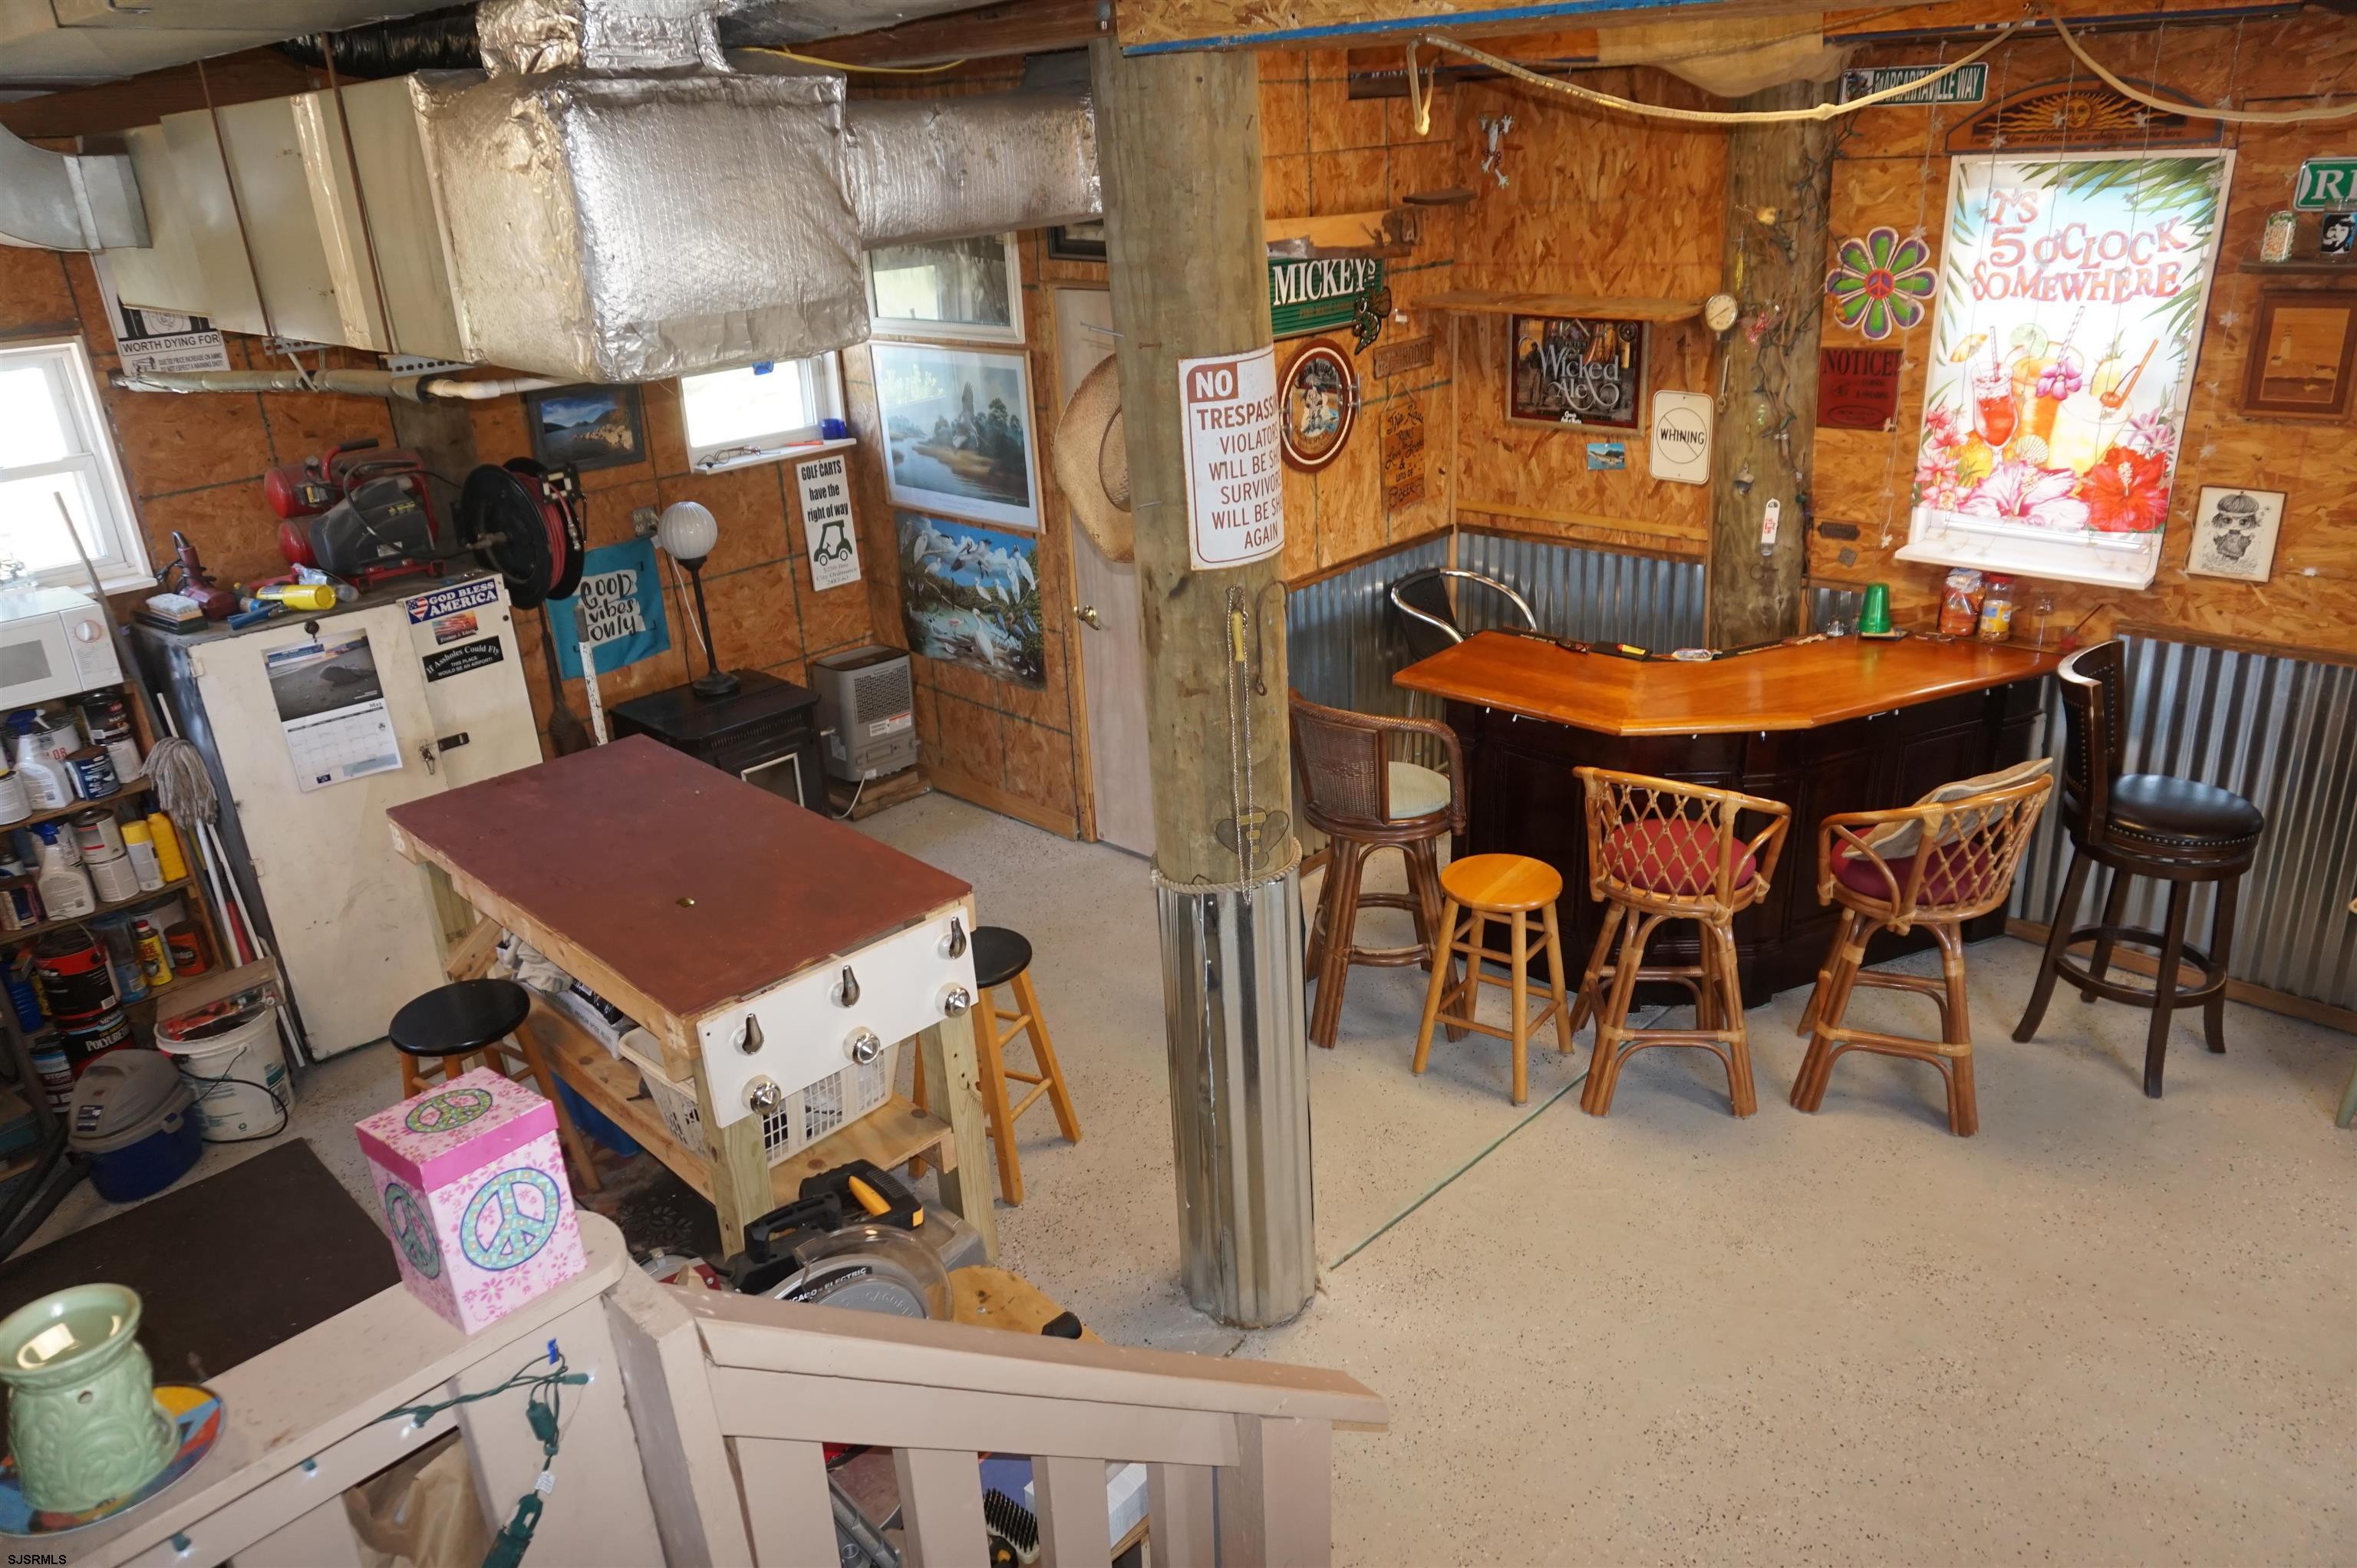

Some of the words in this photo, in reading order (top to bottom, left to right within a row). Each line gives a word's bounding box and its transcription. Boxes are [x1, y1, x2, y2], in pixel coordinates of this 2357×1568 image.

[1956, 68, 1980, 99] WAY
[1989, 226, 2026, 268] 5
[1972, 260, 2181, 304] SOMEWHERE
[123, 340, 161, 354] WORTH
[164, 336, 196, 349] DYING
[199, 334, 219, 344] FOR
[1519, 335, 1621, 406] Wicked
[1195, 369, 1233, 398] NO
[1660, 428, 1705, 444] WHINING
[801, 463, 818, 481] GOLF
[819, 460, 842, 477] CARTS
[1208, 460, 1248, 481] WILL
[1252, 456, 1267, 474] BE
[809, 487, 827, 501] have
[827, 483, 840, 497] the
[807, 507, 826, 522] right
[826, 504, 834, 519] of
[834, 502, 849, 516] way
[1211, 509, 1250, 529] WILL
[1254, 501, 1268, 522] BE
[1244, 520, 1278, 549] AGAIN
[429, 591, 456, 604] GOD
[458, 581, 495, 598] BLESS
[429, 590, 497, 616] AMERICA
[580, 574, 632, 610] GOOD
[588, 598, 634, 623] vibes
[590, 614, 636, 641] only
[426, 664, 434, 674] If
[434, 648, 463, 668] Assholes
[464, 644, 486, 654] Could
[488, 644, 499, 656] Fly
[437, 668, 456, 677] WOULD
[471, 657, 493, 667] AIRPORT!
[463, 655, 478, 664] PLACE
[824, 1267, 867, 1290] ELECTRIC
